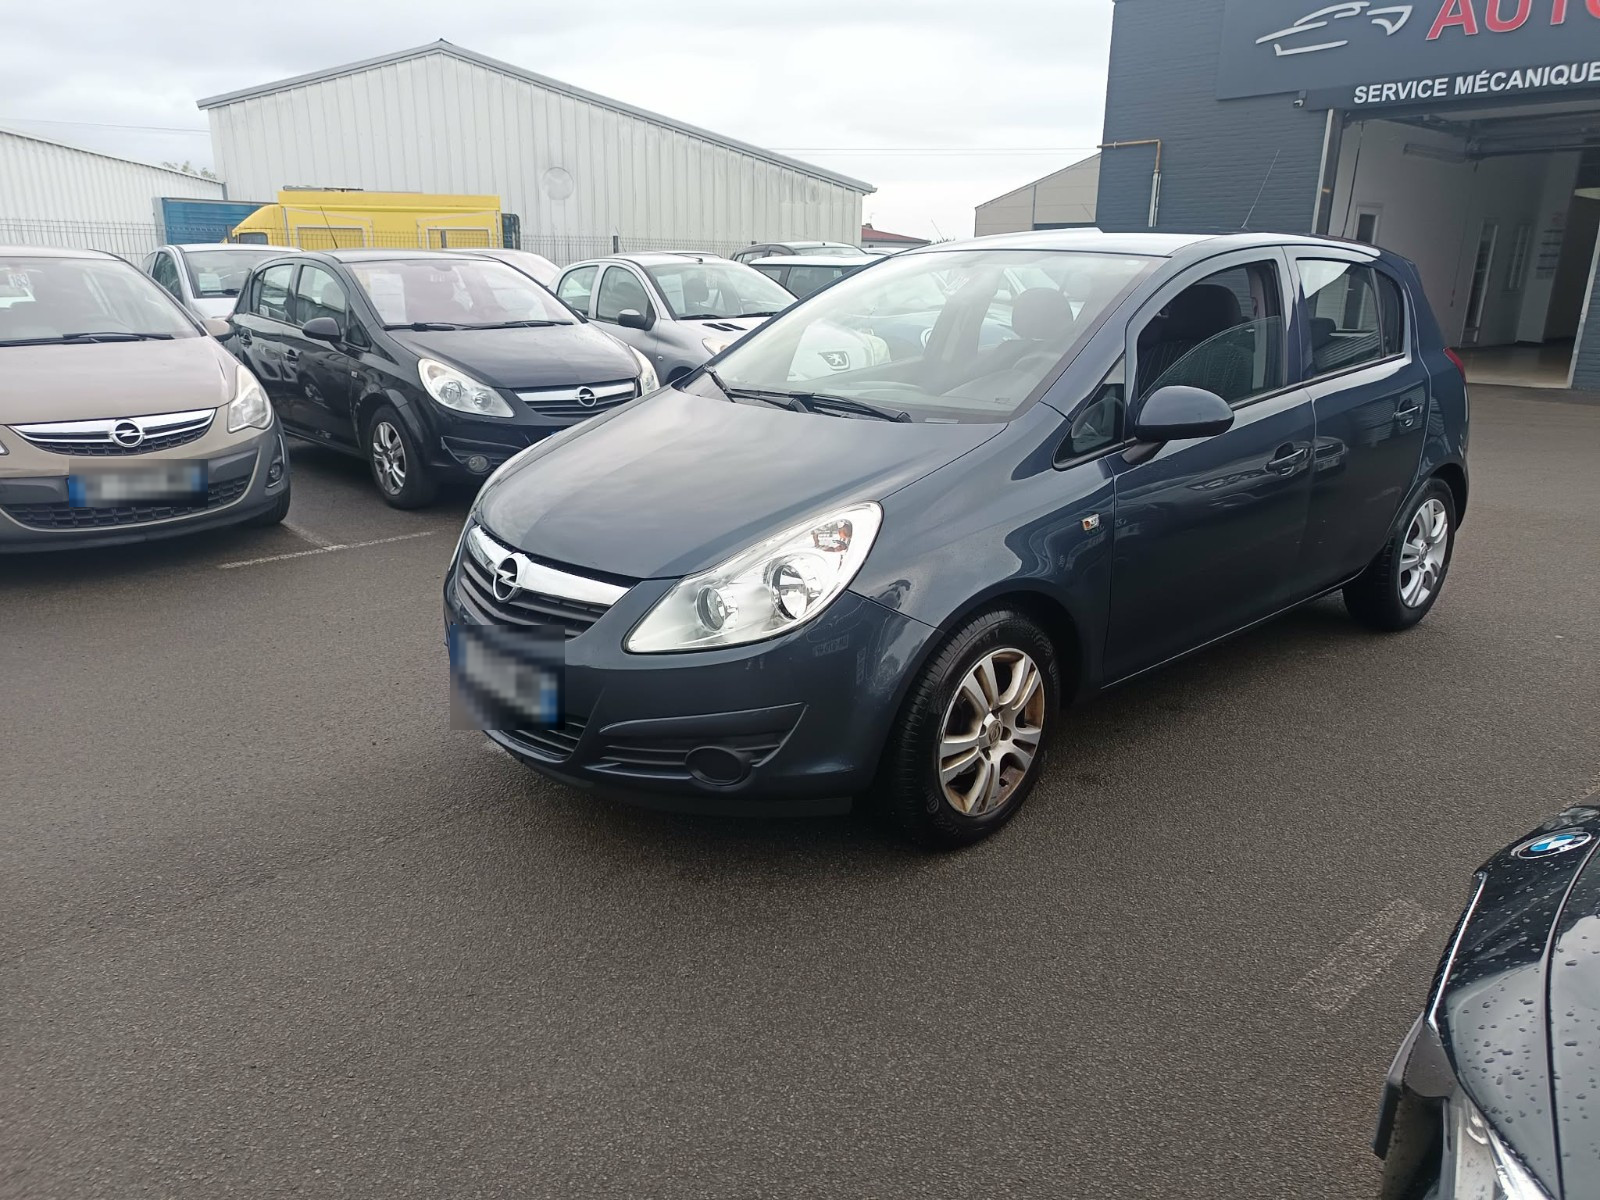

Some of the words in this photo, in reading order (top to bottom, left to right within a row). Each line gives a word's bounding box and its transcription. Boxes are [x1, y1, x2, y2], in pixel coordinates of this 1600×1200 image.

[1425, 0, 1600, 40] AU
[1353, 77, 1449, 104] SERVICE
[1454, 61, 1600, 95] MÉCANIQUE
